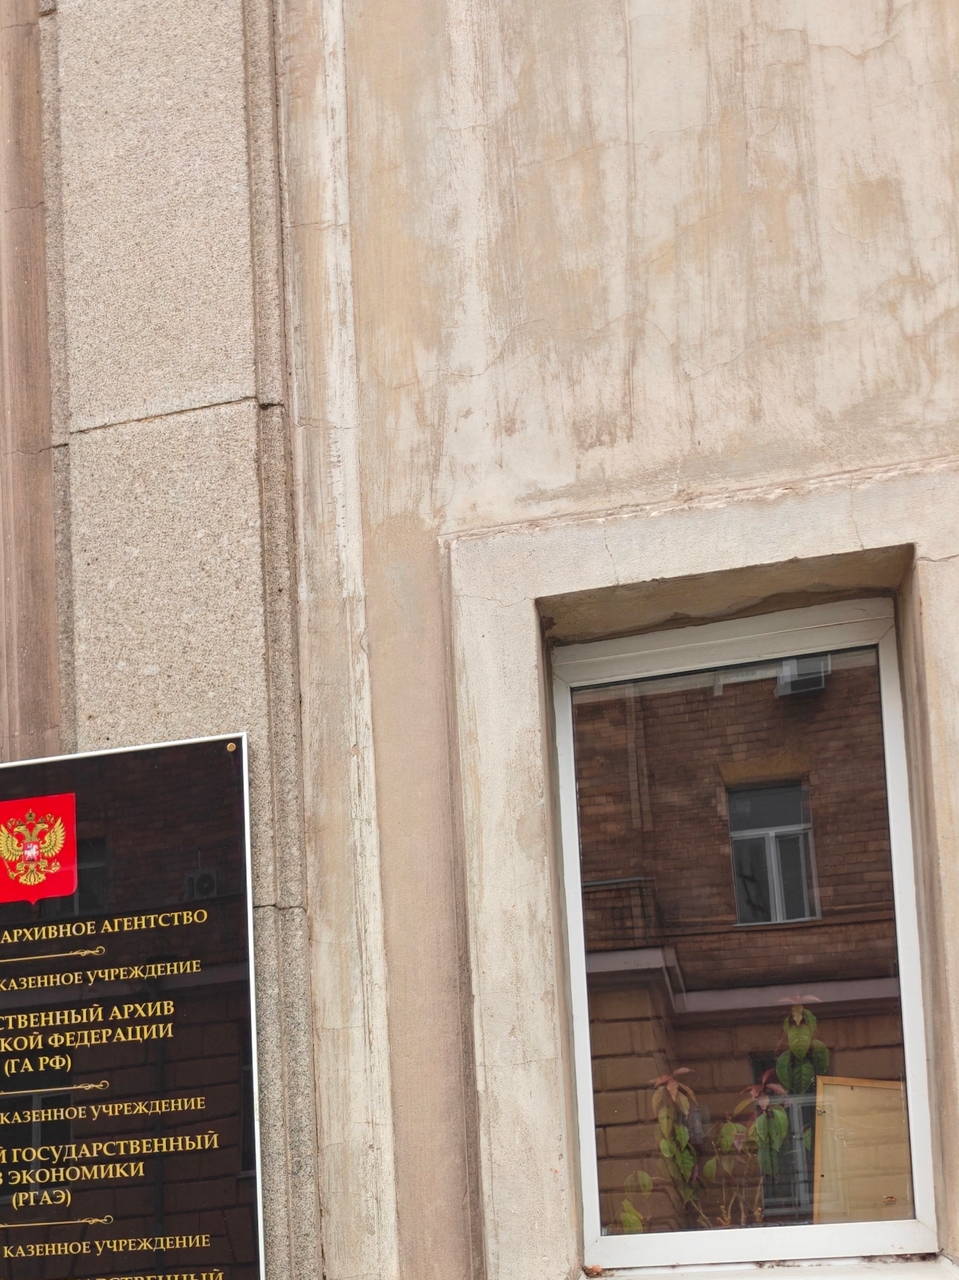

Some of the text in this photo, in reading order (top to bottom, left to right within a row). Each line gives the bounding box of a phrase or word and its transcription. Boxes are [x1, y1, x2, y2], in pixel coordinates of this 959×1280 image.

[1, 921, 96, 944] АРХИВНОЕ
[101, 910, 208, 933] АГЕНТСТВО
[87, 960, 201, 985] УЧРЕЖДЕНИЕ
[108, 1001, 174, 1020] АРХИВ
[48, 1023, 173, 1049] ФЕДЕРАЦИИ
[5, 1055, 71, 1076] (ГА РФ)
[0, 1105, 87, 1125] КАЗЕННОЕ
[92, 1097, 206, 1119] УЧРЕЖДЕНИЕ
[12, 1130, 219, 1163] ГОСУДАРСТВЕННЫЙ
[8, 1162, 144, 1185] ЭКОНОМИКИ
[12, 1189, 72, 1210] (РГАЭ)
[3, 1241, 91, 1258] КАЗЕННОЕ
[95, 1234, 210, 1257] УЧРЕЖДЕНИЕ
